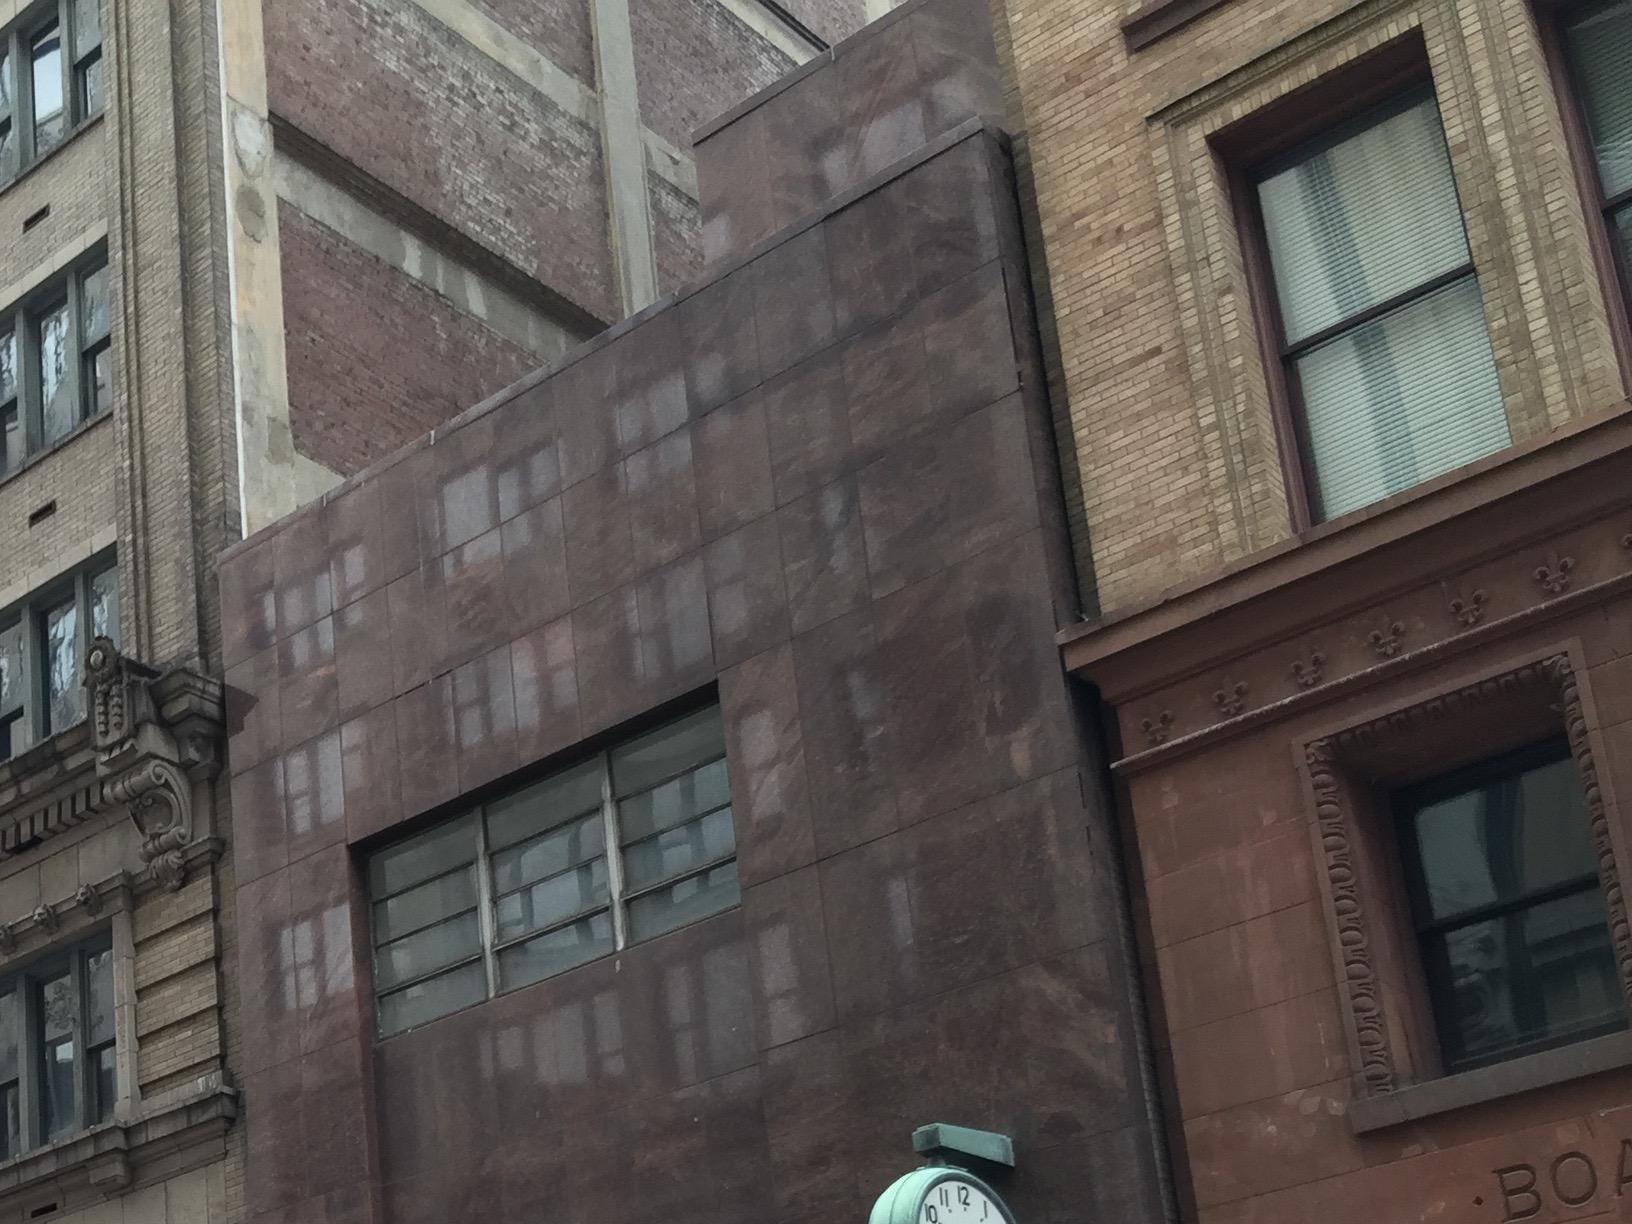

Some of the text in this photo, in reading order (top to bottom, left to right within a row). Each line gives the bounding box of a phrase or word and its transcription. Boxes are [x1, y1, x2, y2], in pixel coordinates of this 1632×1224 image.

[939, 1187, 949, 1207] 11
[957, 1186, 970, 1207] 12
[924, 1204, 939, 1224] 10
